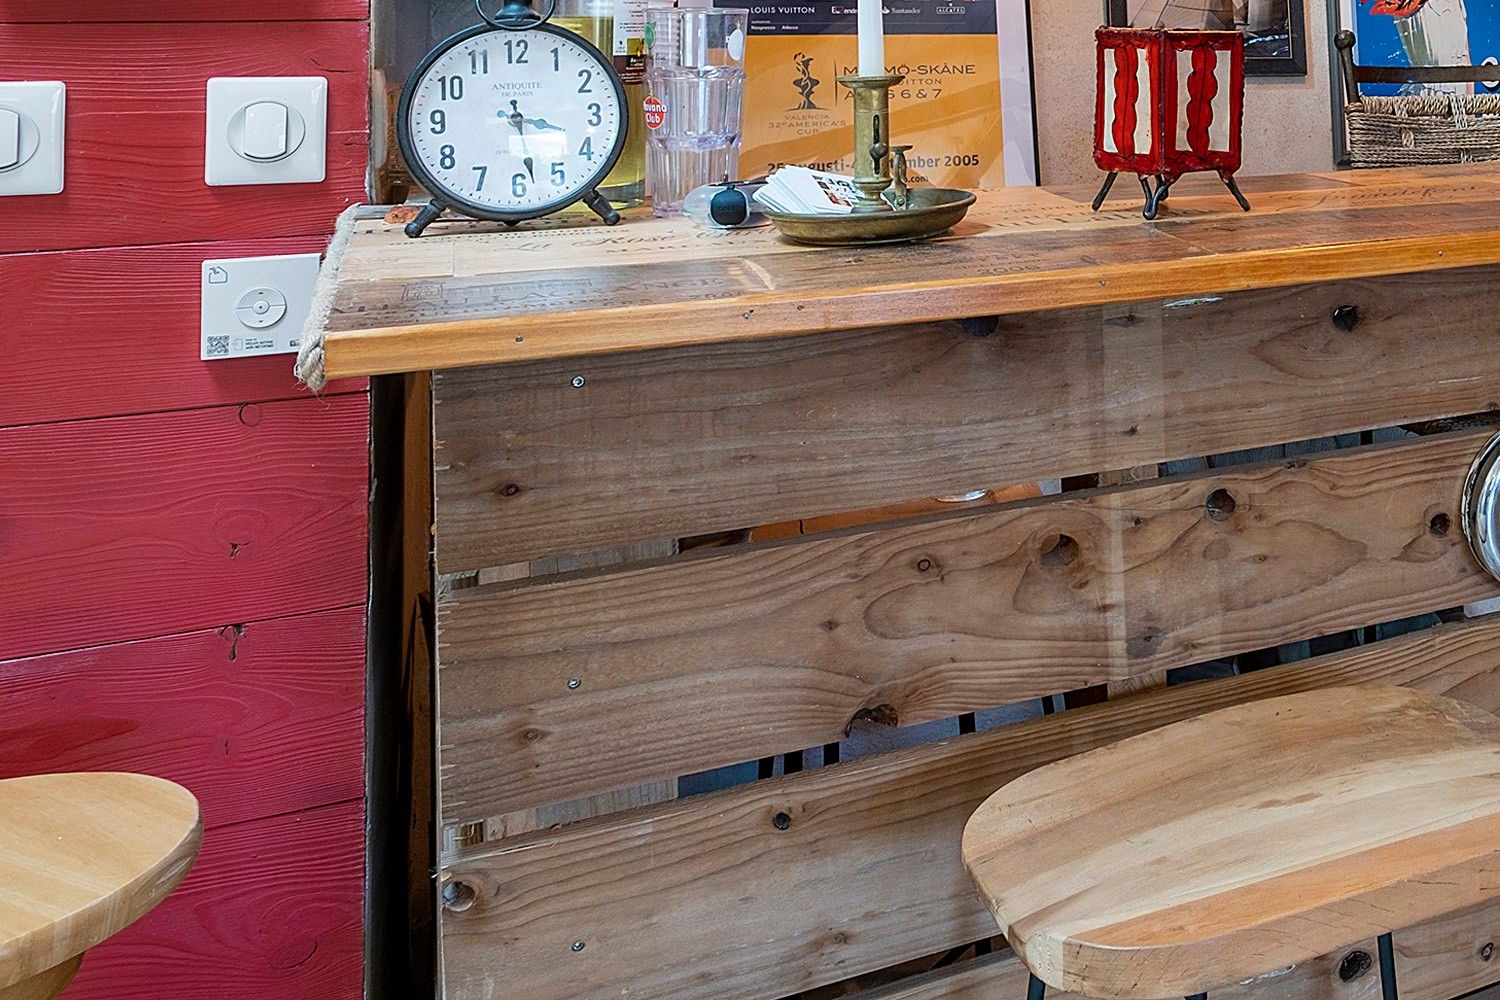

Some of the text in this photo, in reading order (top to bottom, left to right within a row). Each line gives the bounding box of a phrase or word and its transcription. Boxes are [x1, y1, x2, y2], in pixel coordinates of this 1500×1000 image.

[778, 6, 815, 14] VUITTON
[891, 7, 922, 15] Santander
[468, 50, 488, 75] 11
[504, 40, 529, 64] 12
[550, 47, 559, 72] 1
[577, 69, 592, 93] 2
[844, 63, 976, 75] MMÖ-SKÅNE
[438, 75, 464, 101] 10
[492, 82, 542, 90] ANTIQUITE
[901, 89, 909, 98] 6
[917, 89, 928, 98] &
[933, 89, 942, 98] 7
[430, 109, 446, 135] 9
[587, 103, 602, 127] 3
[440, 145, 456, 170] 8
[578, 136, 594, 161] 4
[944, 154, 980, 167] 2005
[472, 167, 488, 192] 7
[511, 173, 527, 198] 6
[550, 162, 566, 187] 5
